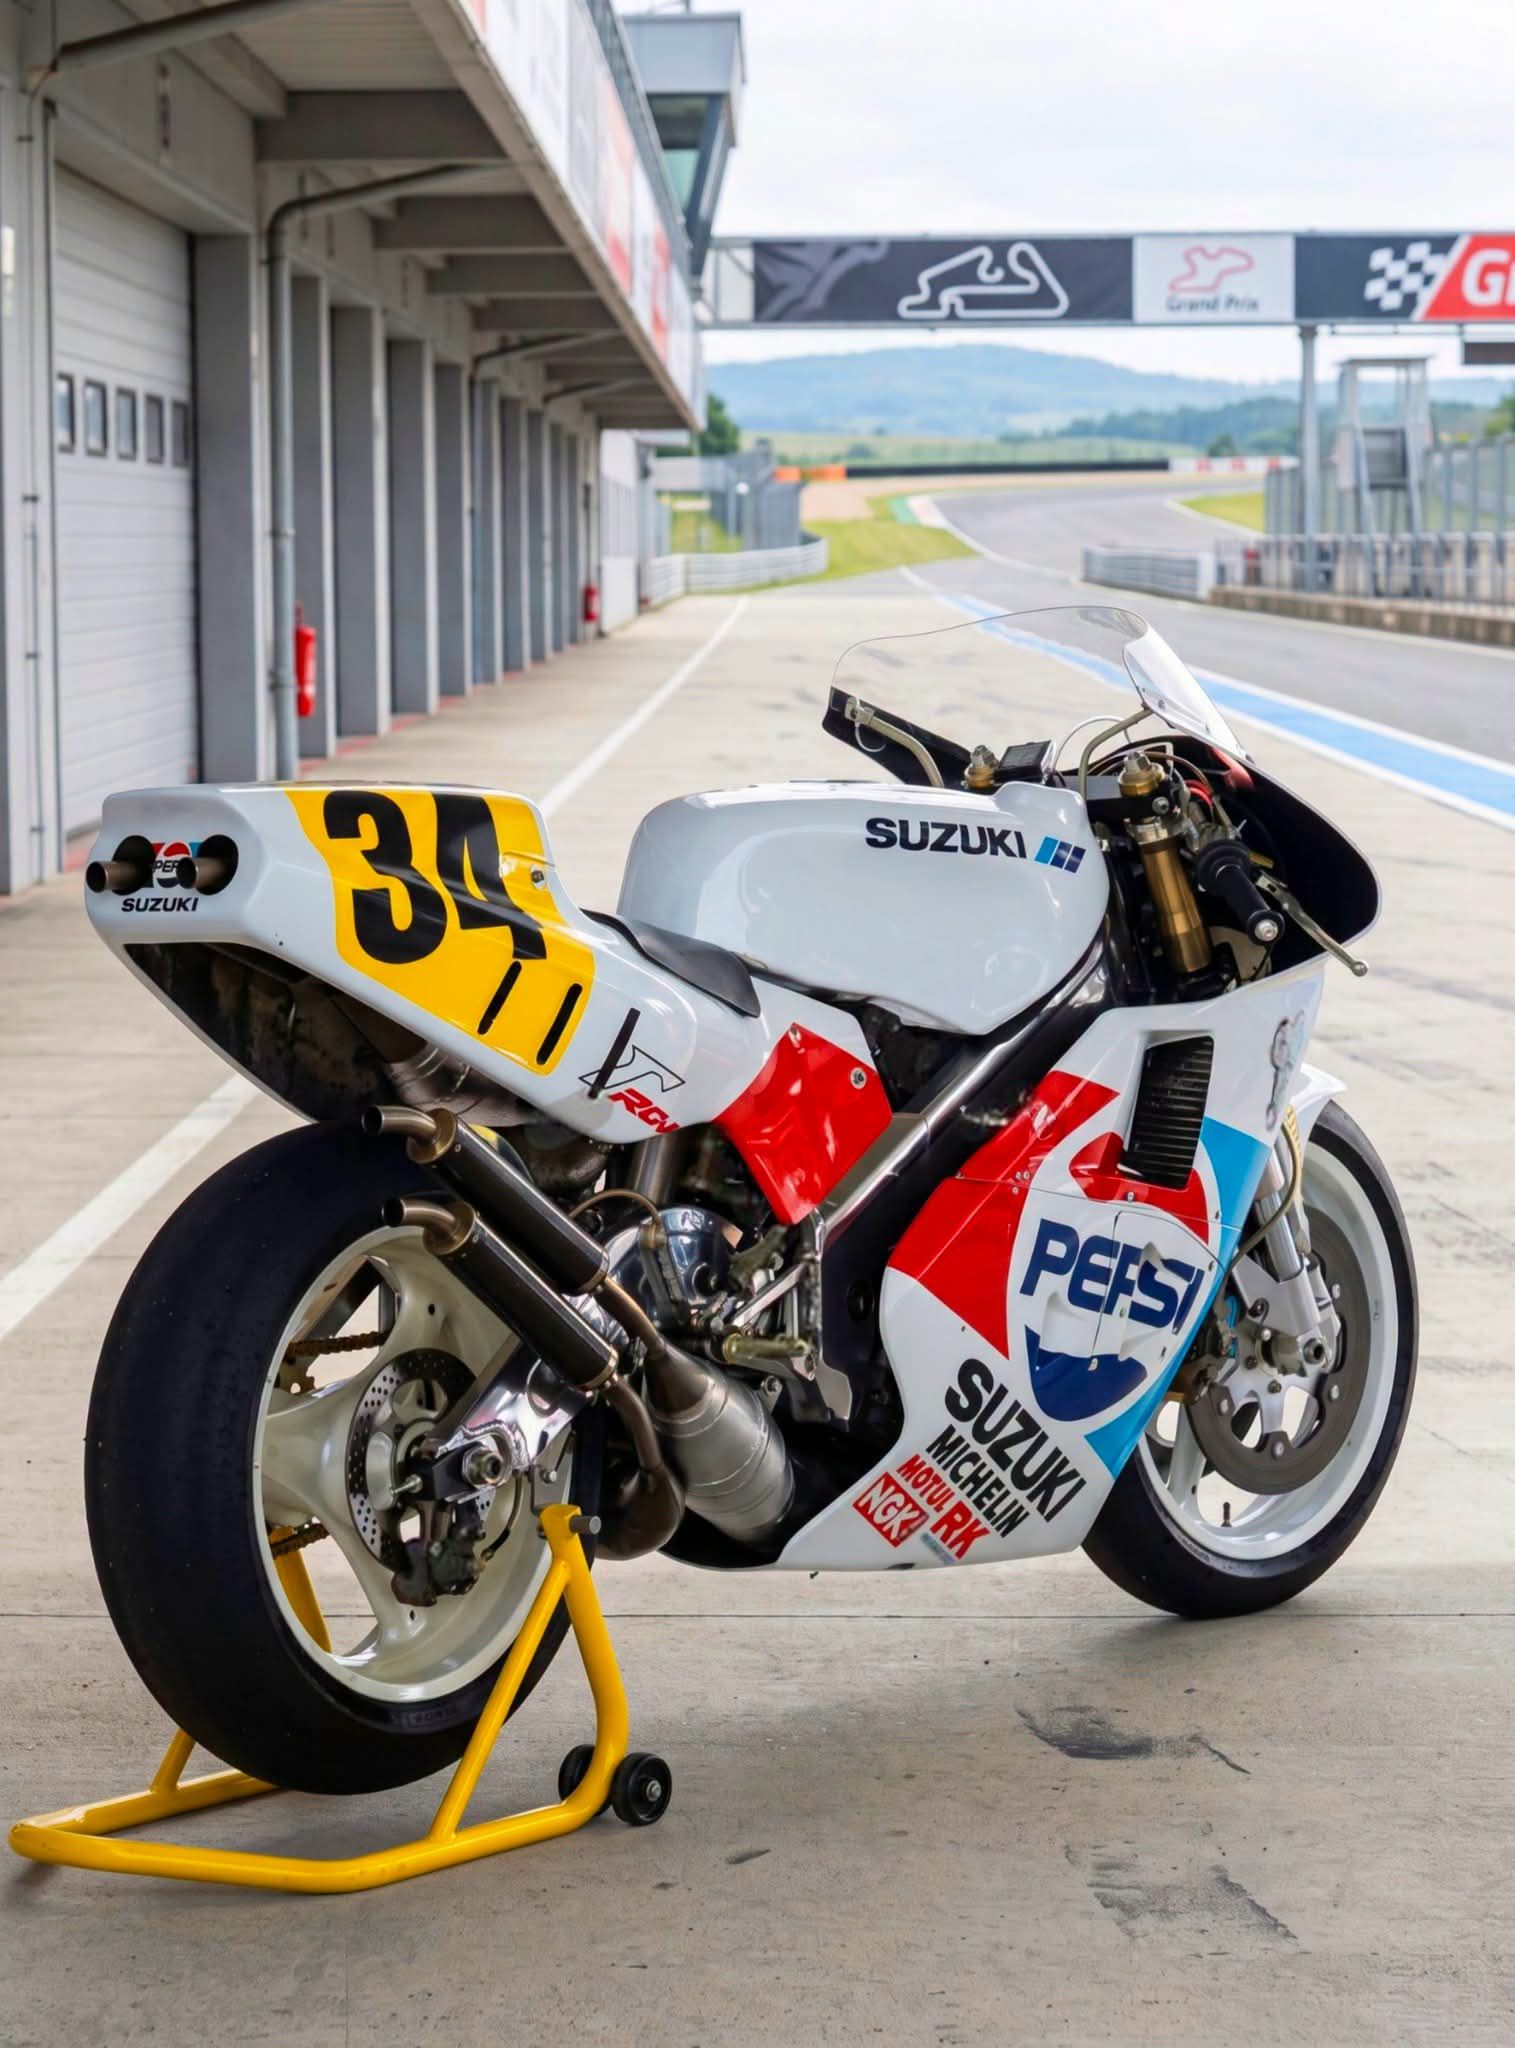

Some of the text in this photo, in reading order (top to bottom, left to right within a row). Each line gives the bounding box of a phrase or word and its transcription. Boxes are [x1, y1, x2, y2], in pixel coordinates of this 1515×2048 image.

[324, 790, 547, 964] 34
[865, 817, 1027, 859] SUZUKI
[121, 897, 199, 912] SUZUKI
[1019, 1218, 1205, 1335] PEPSI
[896, 1454, 955, 1512] MOTUL
[926, 1424, 1030, 1538] MICHELIN
[945, 1358, 1087, 1522] SUZUKI
[930, 1500, 990, 1559] RK
